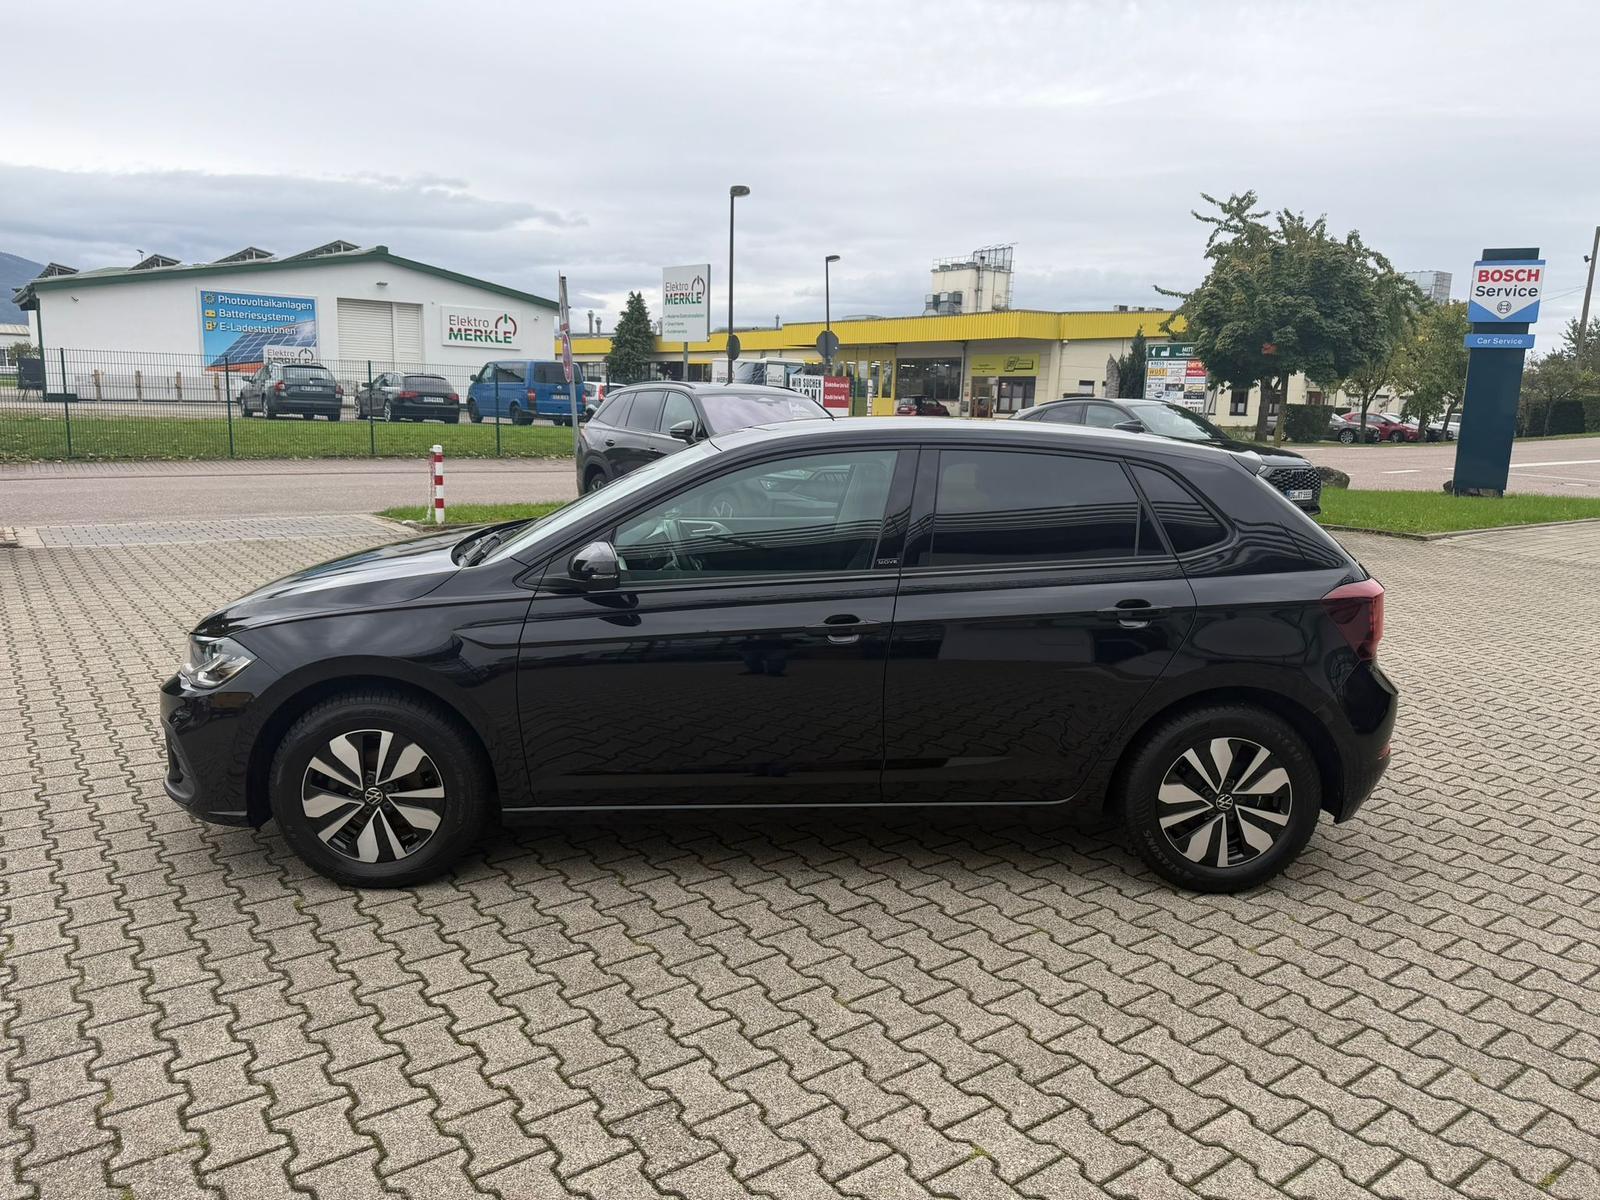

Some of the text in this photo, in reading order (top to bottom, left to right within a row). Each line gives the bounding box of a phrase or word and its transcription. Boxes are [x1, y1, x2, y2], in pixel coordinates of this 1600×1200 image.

[1478, 269, 1540, 282] BOSCH
[665, 282, 689, 292] Elektro
[1475, 285, 1538, 297] Service
[218, 295, 313, 311] Photovoltaikanlagen
[665, 292, 702, 305] MERKLE
[219, 308, 296, 322] Batteriesysteme
[449, 314, 490, 328] Elektro
[220, 322, 297, 335] E-Ladestationen
[448, 327, 513, 344] MERKLE
[1477, 337, 1523, 345] Car Service
[268, 348, 295, 358] Elektro
